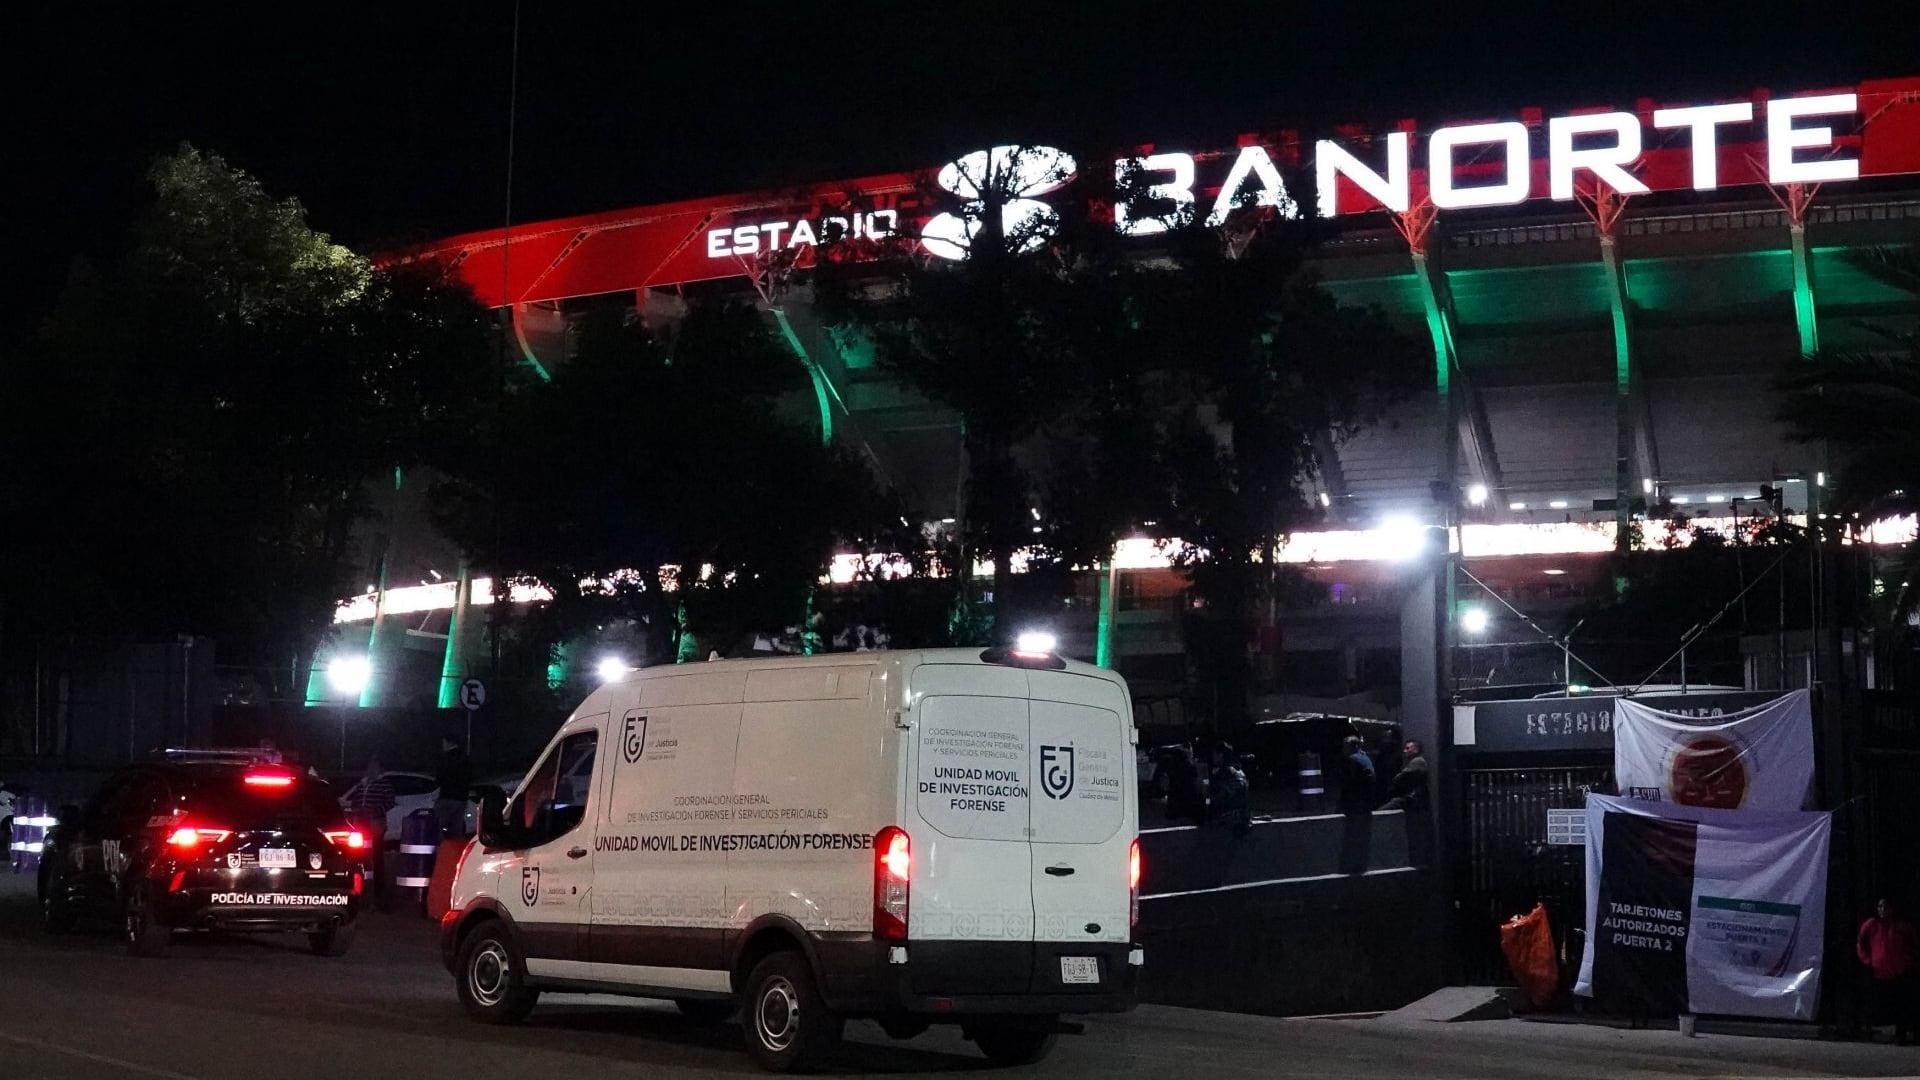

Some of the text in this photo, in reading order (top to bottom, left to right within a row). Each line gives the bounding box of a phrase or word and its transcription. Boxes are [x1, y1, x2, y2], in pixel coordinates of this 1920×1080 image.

[707, 93, 1859, 258] ESTADIO BANORTE
[988, 731, 1019, 741] GENERAL
[924, 737, 935, 745] DE
[994, 741, 1025, 752] FORENSE
[940, 748, 979, 757] SERVICIOS
[980, 750, 1018, 760] PERICIALES
[934, 767, 1020, 783] UNIDAD MOVIL
[1091, 775, 1119, 787] Justicia
[919, 782, 1028, 798] DE INVESTIGACIÓN
[734, 794, 770, 805] GENERAL
[950, 798, 1006, 812] FORENSE
[627, 812, 638, 823] DE
[695, 809, 729, 821] FORENSE
[731, 809, 736, 819] Y
[738, 809, 779, 820] SERVICIOS
[780, 808, 829, 819] PERICIALES
[595, 829, 871, 852] UNIDAD MOVIL DE INVESTIGACIÓN FORENSE
[211, 892, 348, 905] POLICÍA DE INVESTIGACIÓN
[1609, 902, 1683, 921] TARJETONES
[1602, 916, 1685, 937] AUTORIZADOS
[1707, 921, 1789, 937] ESTACIONAMIENTO
[1613, 932, 1673, 951] PUERTA 2
